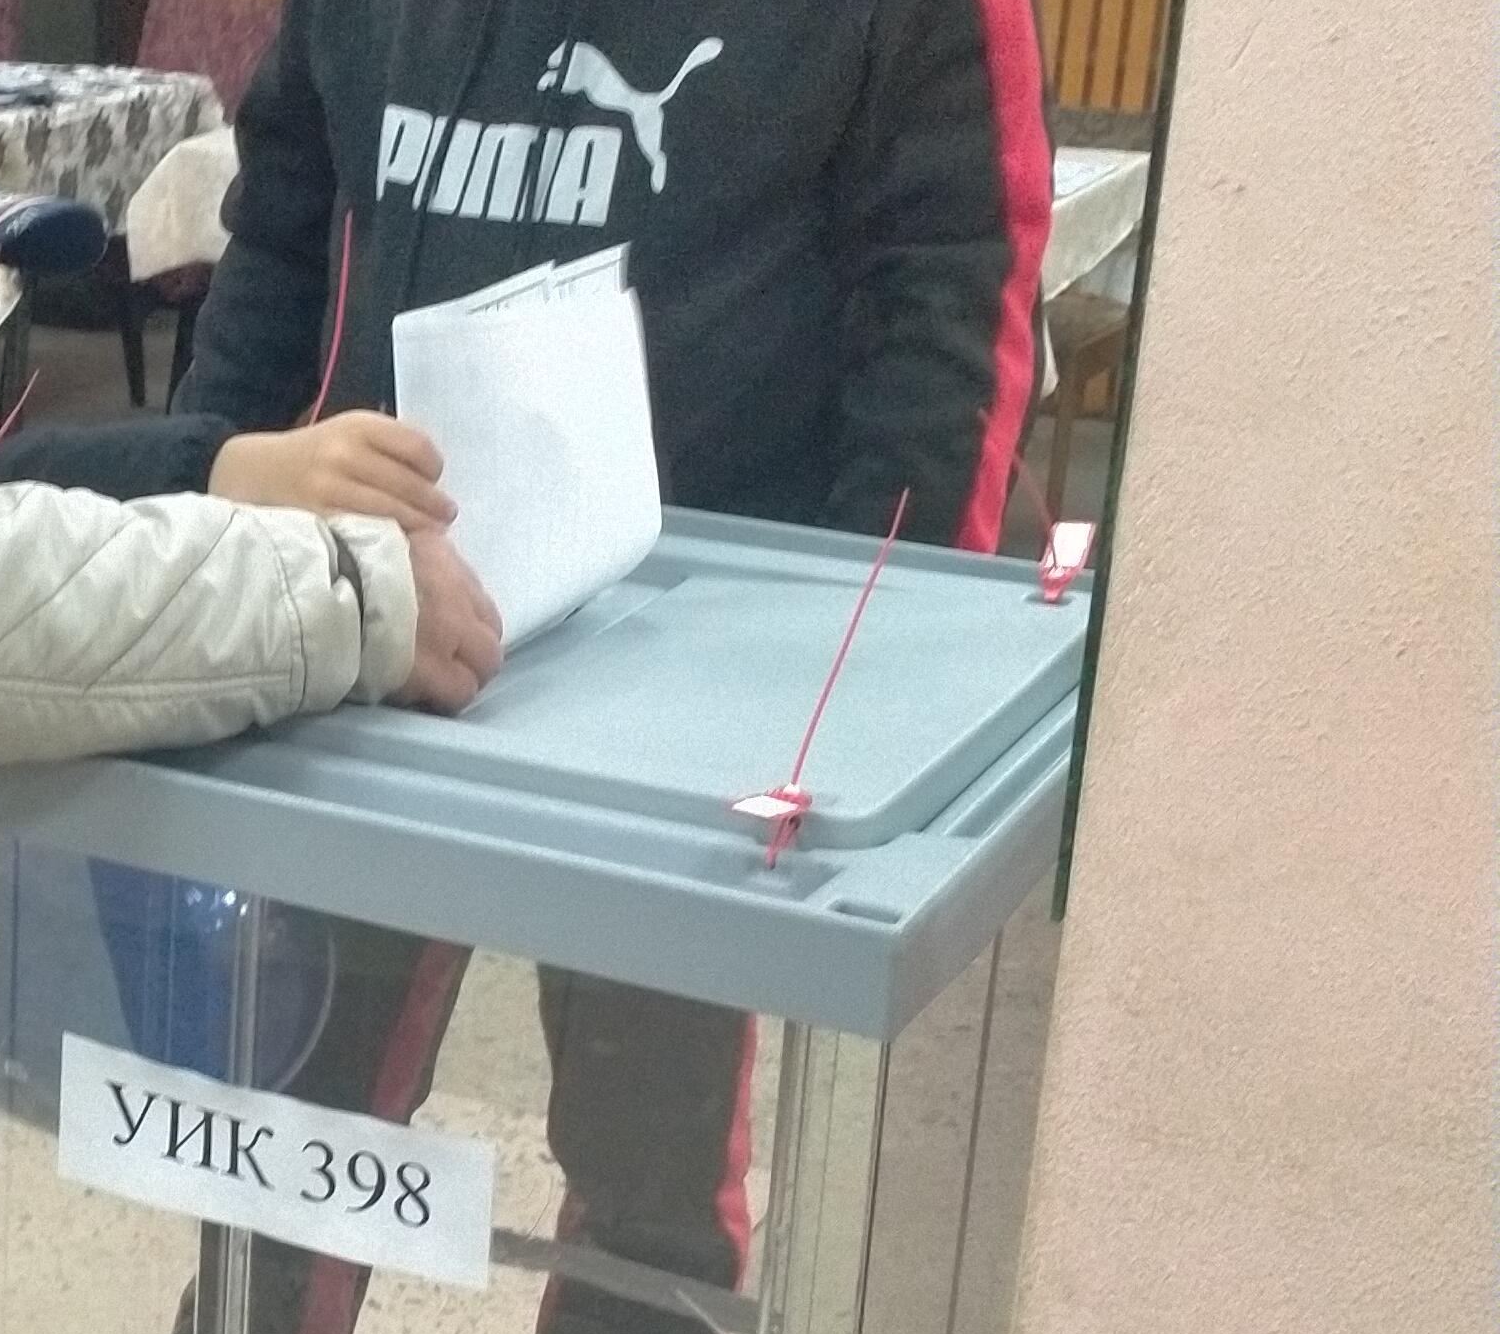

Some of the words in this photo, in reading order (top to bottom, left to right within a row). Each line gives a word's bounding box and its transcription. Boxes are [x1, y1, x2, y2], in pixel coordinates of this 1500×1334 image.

[376, 103, 622, 226] PUMA
[106, 1081, 275, 1191] УИК
[300, 1139, 431, 1228] 398
